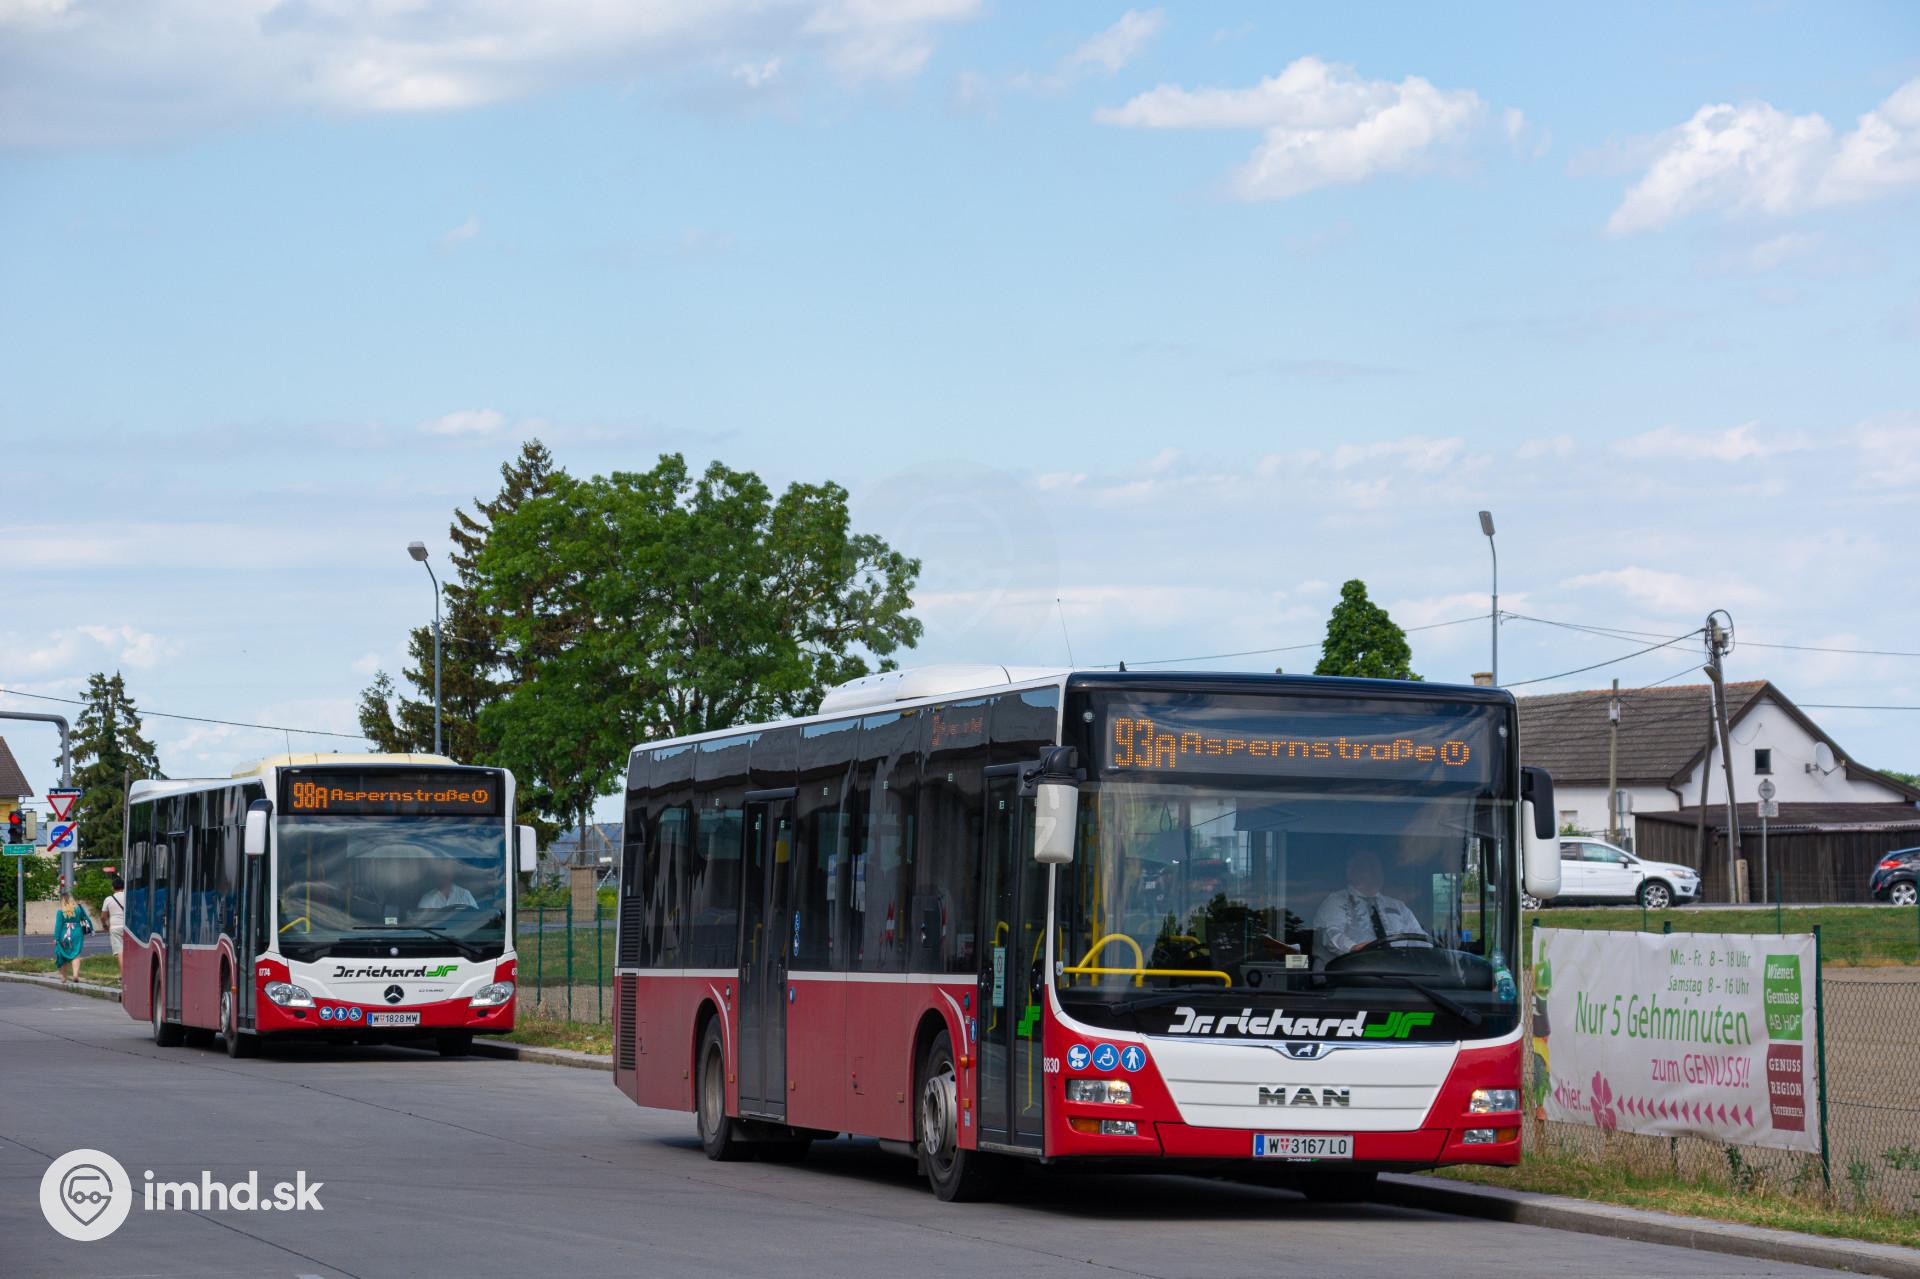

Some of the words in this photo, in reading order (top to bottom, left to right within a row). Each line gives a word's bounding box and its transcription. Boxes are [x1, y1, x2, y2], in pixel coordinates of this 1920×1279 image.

[1115, 717, 1176, 768] 93A
[1181, 731, 1436, 762] Aspernstraße
[293, 782, 328, 809] 98A
[330, 787, 470, 802] Aspernstraße
[1670, 949, 1686, 966] Mo.
[1709, 950, 1716, 967] 8
[1726, 951, 1735, 967] 18
[1736, 951, 1751, 968] Uhr
[1767, 963, 1795, 980] Wiener
[1667, 975, 1703, 997] Samstag
[1708, 976, 1714, 993] 8
[1724, 977, 1734, 994] 16
[1735, 976, 1750, 995] Uhr
[1766, 988, 1800, 1005] Gemüse
[373, 1014, 380, 1023] W
[1575, 991, 1607, 1035] Nur
[1610, 995, 1622, 1036] 5
[1627, 993, 1752, 1046] Gehminuten
[1769, 1014, 1782, 1031] AB
[1783, 1014, 1801, 1031] HOF
[1651, 1058, 1681, 1082] zum
[1683, 1053, 1751, 1089] GENUSS!!
[1768, 1058, 1801, 1073] GENUSS
[1258, 1086, 1350, 1107] MAN
[1770, 1081, 1802, 1097] REGION
[1269, 1138, 1279, 1154] W
[1291, 1138, 1325, 1154] 3167
